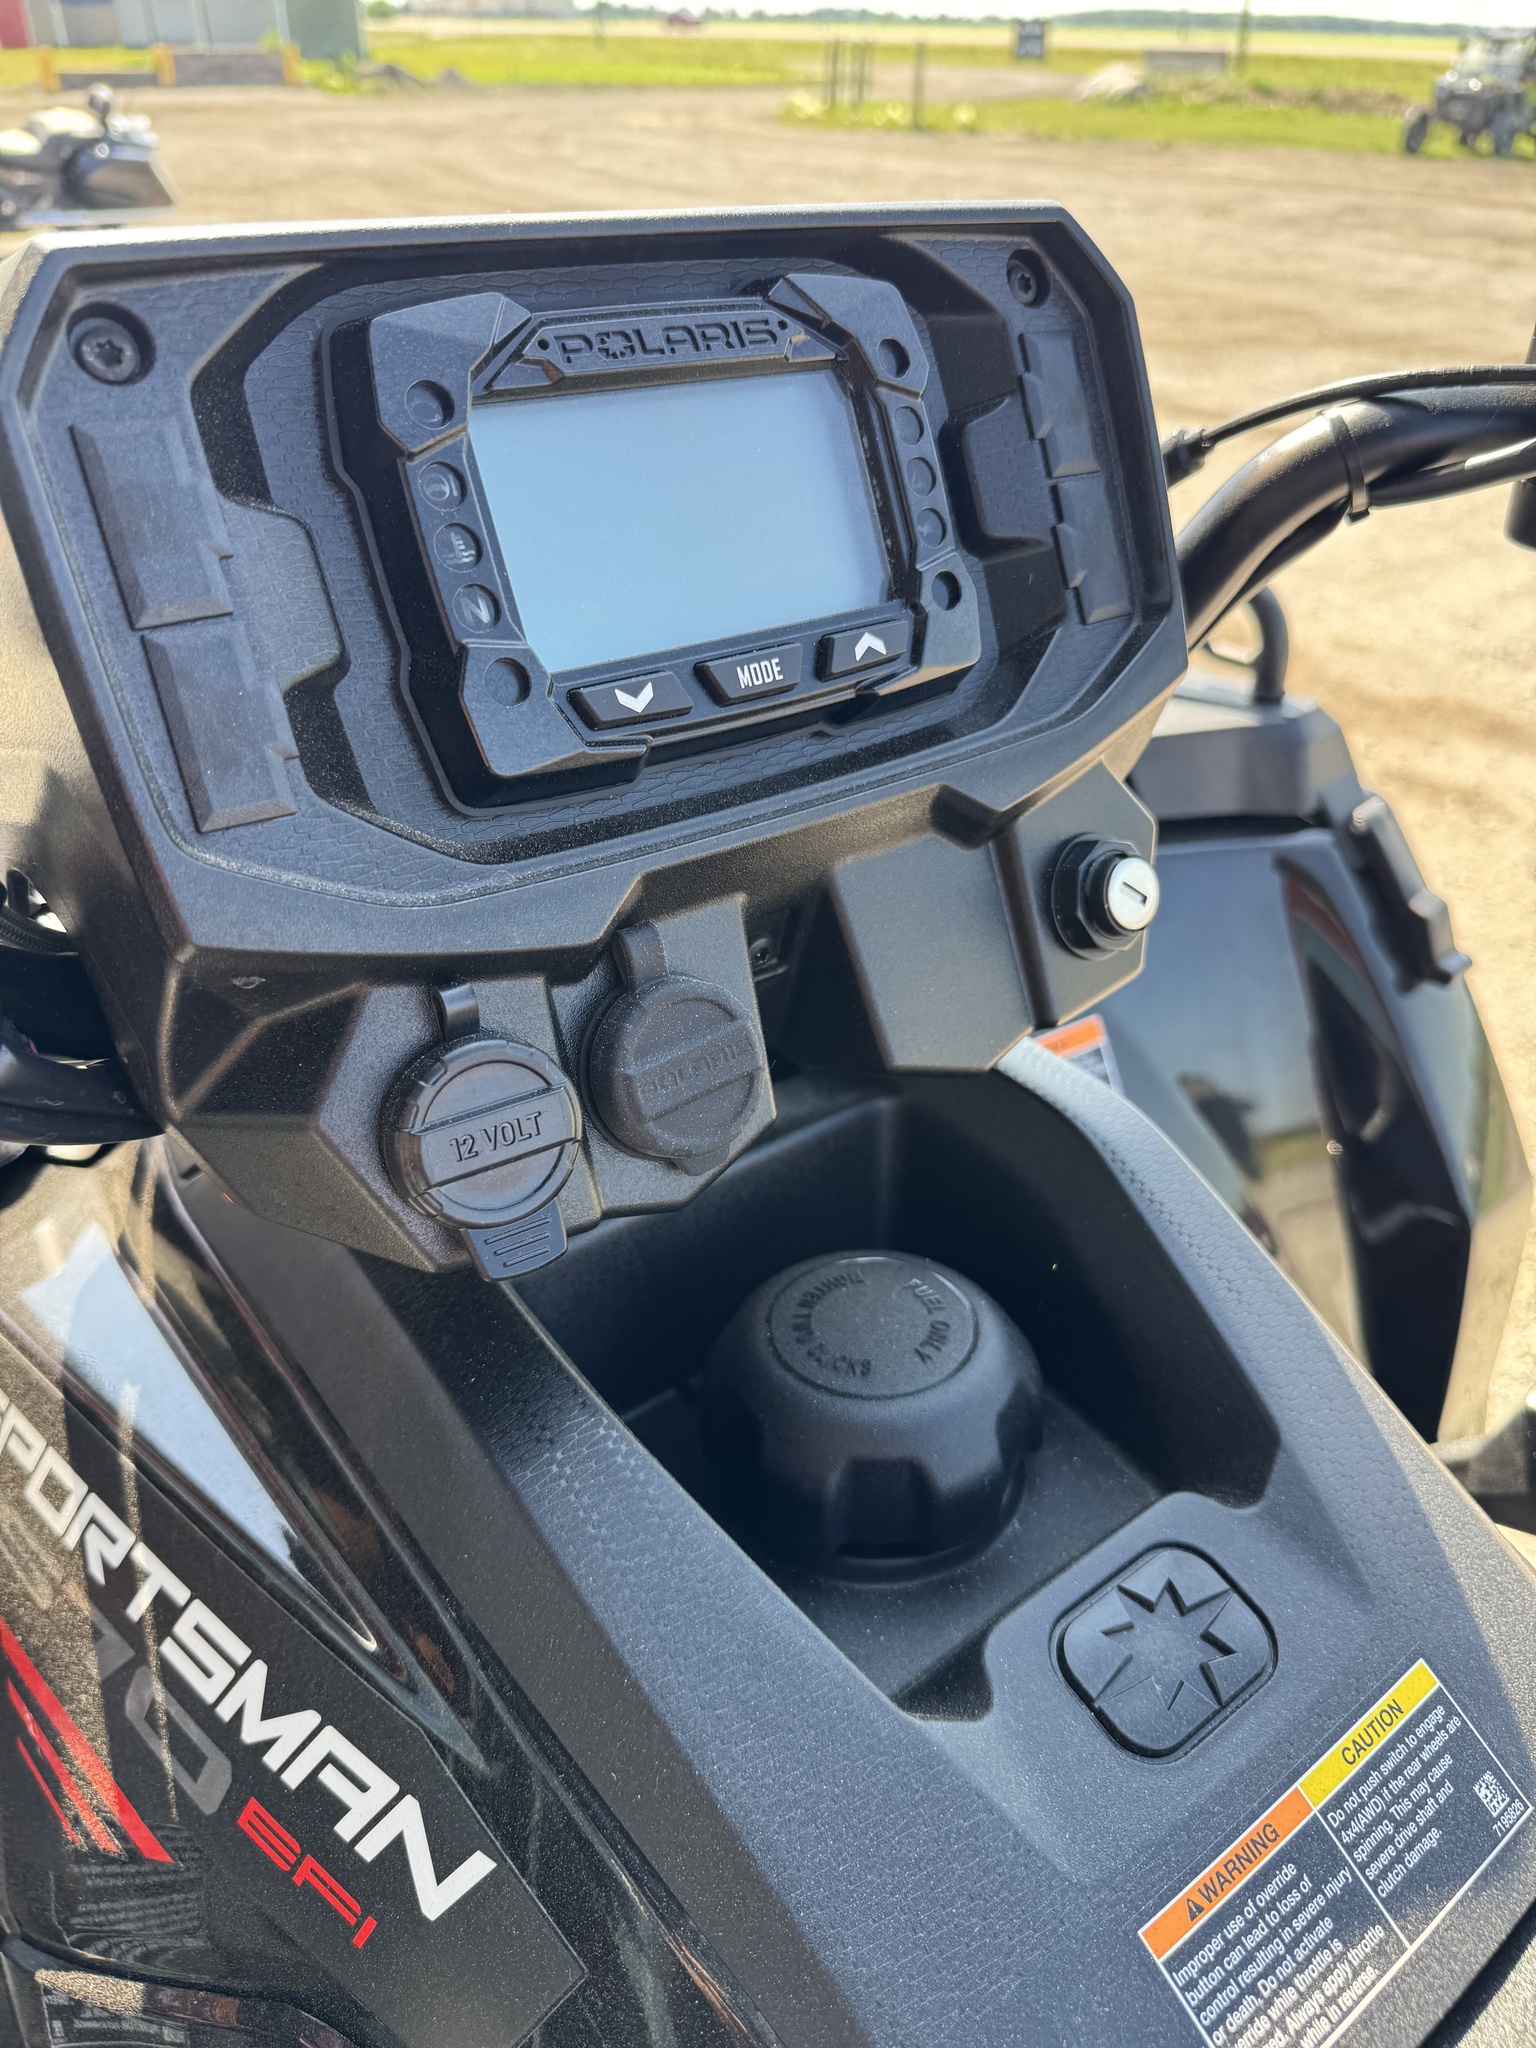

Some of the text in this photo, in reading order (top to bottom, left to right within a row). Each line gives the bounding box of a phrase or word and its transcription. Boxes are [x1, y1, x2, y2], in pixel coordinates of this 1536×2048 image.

[552, 318, 778, 367] POLARIS
[736, 657, 784, 689] MODE
[449, 1111, 542, 1162] 12 VOLT
[902, 1277, 951, 1364] FUEL ONLY
[0, 1388, 497, 1922] PORTSMAN
[1327, 1705, 1445, 1828] Do not push switch to engage
[1342, 1699, 1404, 1765] CAUTION
[1342, 1716, 1461, 1843] 4x4(AWD) if the rear wheels are
[1354, 1754, 1452, 1862] spinning. This may cause
[1366, 1779, 1454, 1880] severe drive shaft and
[1493, 1799, 1524, 1837] 7195826
[237, 1796, 378, 1949] EFI
[1198, 1824, 1280, 1903] WARNING
[1378, 1828, 1442, 1897] clutch damage.
[1173, 1864, 1296, 1986] Improper use of override
[1185, 1873, 1312, 2006] button can lead to loss of
[1200, 1979, 1240, 2026] control
[1238, 1938, 1285, 1988] resulting
[1279, 1927, 1294, 1943] in
[1292, 1894, 1325, 1932] severe
[1322, 1867, 1352, 1898] injury
[1213, 1917, 1333, 2046] or death. Do not activate
[1232, 2011, 1272, 2048] erride
[1267, 1987, 1298, 2021] while
[1294, 1950, 1333, 1992] throttle
[1328, 1939, 1343, 1955] is
[1286, 1925, 1385, 2036] Always apply throttle
[1299, 1962, 1379, 2048] while in reverse.
